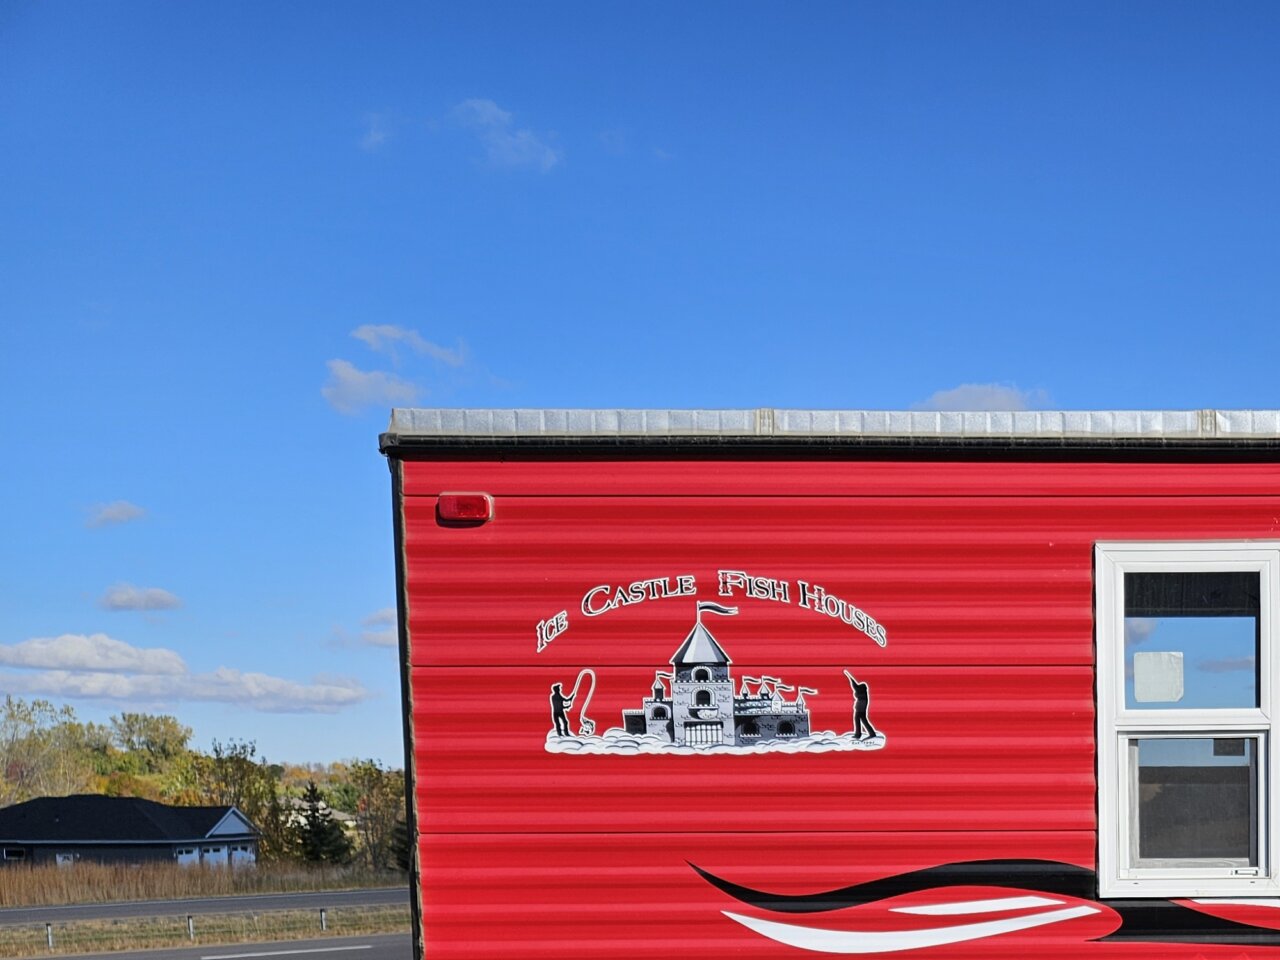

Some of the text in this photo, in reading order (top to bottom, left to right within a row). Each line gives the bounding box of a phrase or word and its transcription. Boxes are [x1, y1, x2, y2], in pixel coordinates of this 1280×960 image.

[536, 570, 888, 653] ICE CASTLE FISH HOUSES
